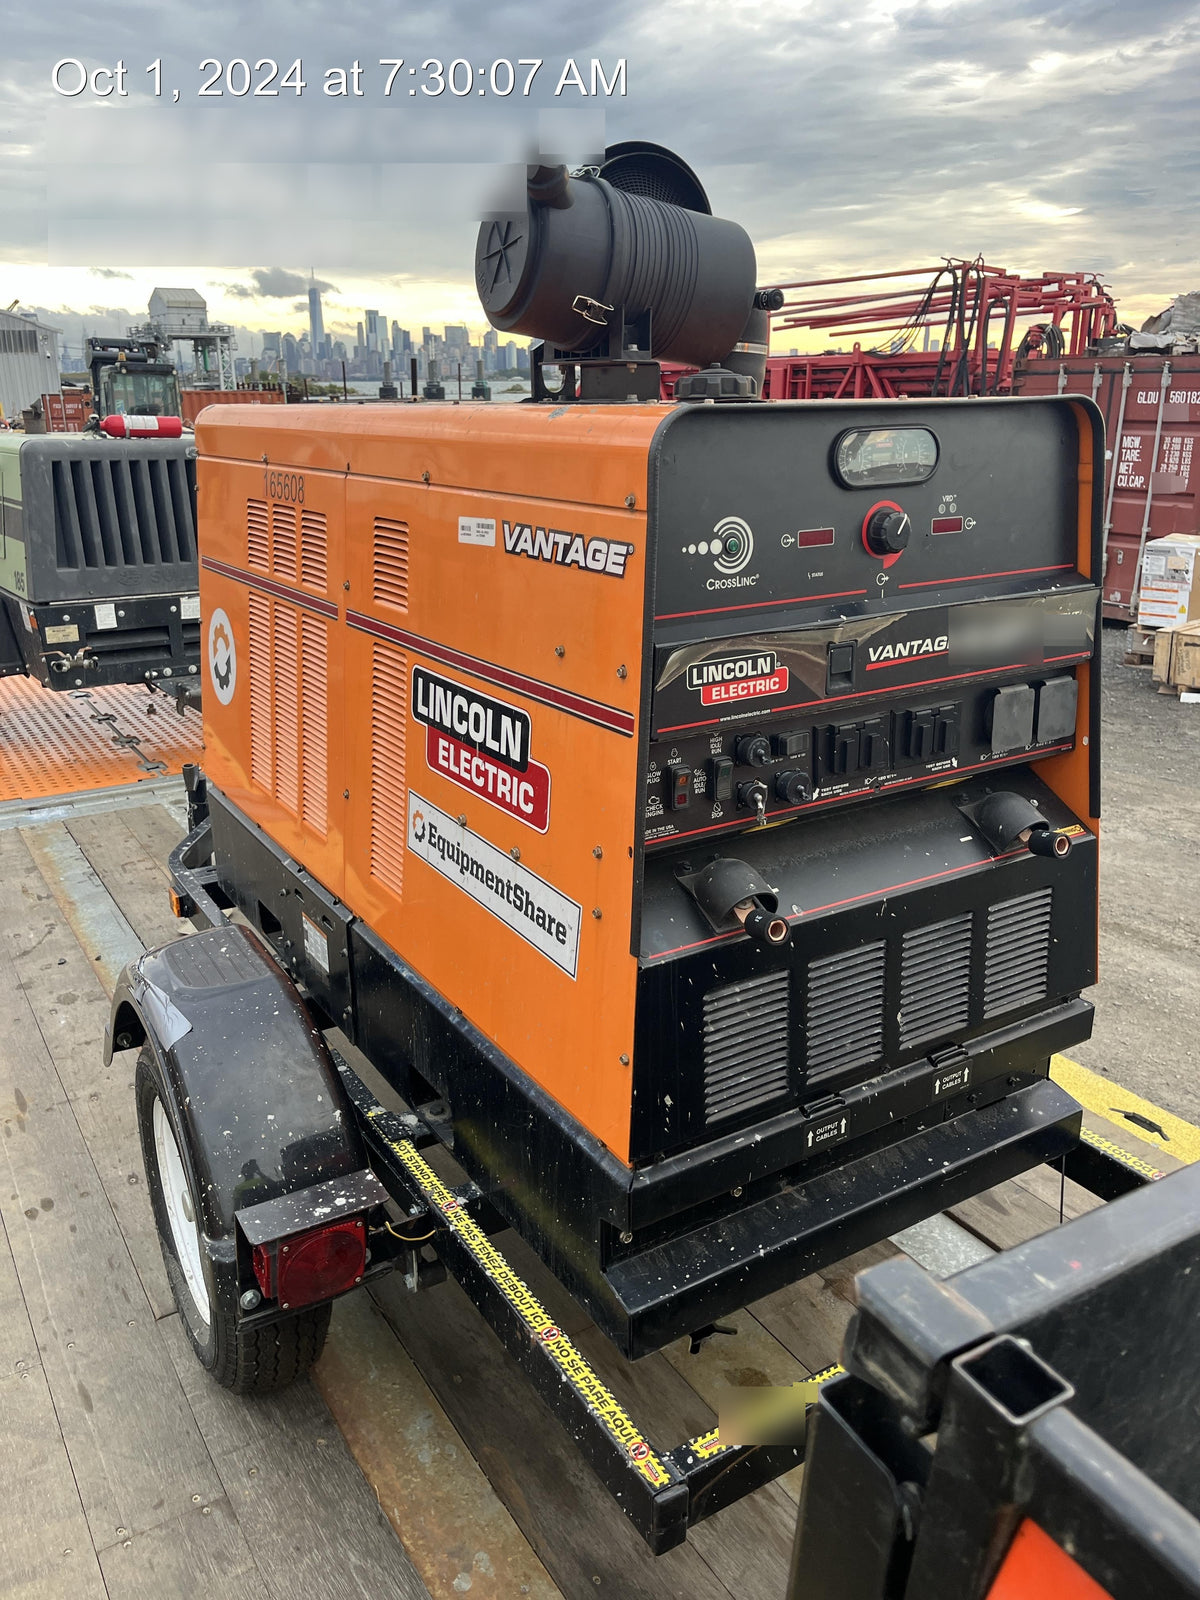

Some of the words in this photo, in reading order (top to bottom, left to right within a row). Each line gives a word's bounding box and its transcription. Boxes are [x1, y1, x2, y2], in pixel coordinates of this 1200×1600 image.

[1137, 391, 1159, 404] GLDU
[1122, 436, 1142, 448] MGW.
[264, 472, 305, 504] 165608
[503, 522, 629, 576] VANTAGE
[868, 635, 949, 662] VANTAG
[692, 656, 771, 685] LINCOLN
[711, 677, 780, 700] ELECTRIC
[416, 676, 523, 763] LINCOLN
[667, 757, 682, 765] START
[438, 737, 535, 815] ELECTRIC
[647, 771, 661, 779] LOW
[647, 777, 660, 785] PLUG
[645, 804, 664, 812] CHECK
[711, 811, 724, 819] STOP
[428, 821, 567, 946] EquipmentShare
[942, 1071, 962, 1083] OUTPUT
[942, 1077, 962, 1090] CABLES
[815, 1121, 839, 1135] OUTPUT
[815, 1129, 839, 1142] CABLES
[407, 1155, 431, 1181] STAND
[427, 1180, 449, 1202] HERE
[452, 1211, 465, 1223] NE
[463, 1223, 480, 1241] PAS
[476, 1241, 502, 1270] TENEZ
[498, 1270, 535, 1312] DEBOUT
[530, 1311, 546, 1327] ICI
[552, 1340, 570, 1358] NO
[567, 1358, 585, 1376] SE
[580, 1375, 611, 1409] PARE
